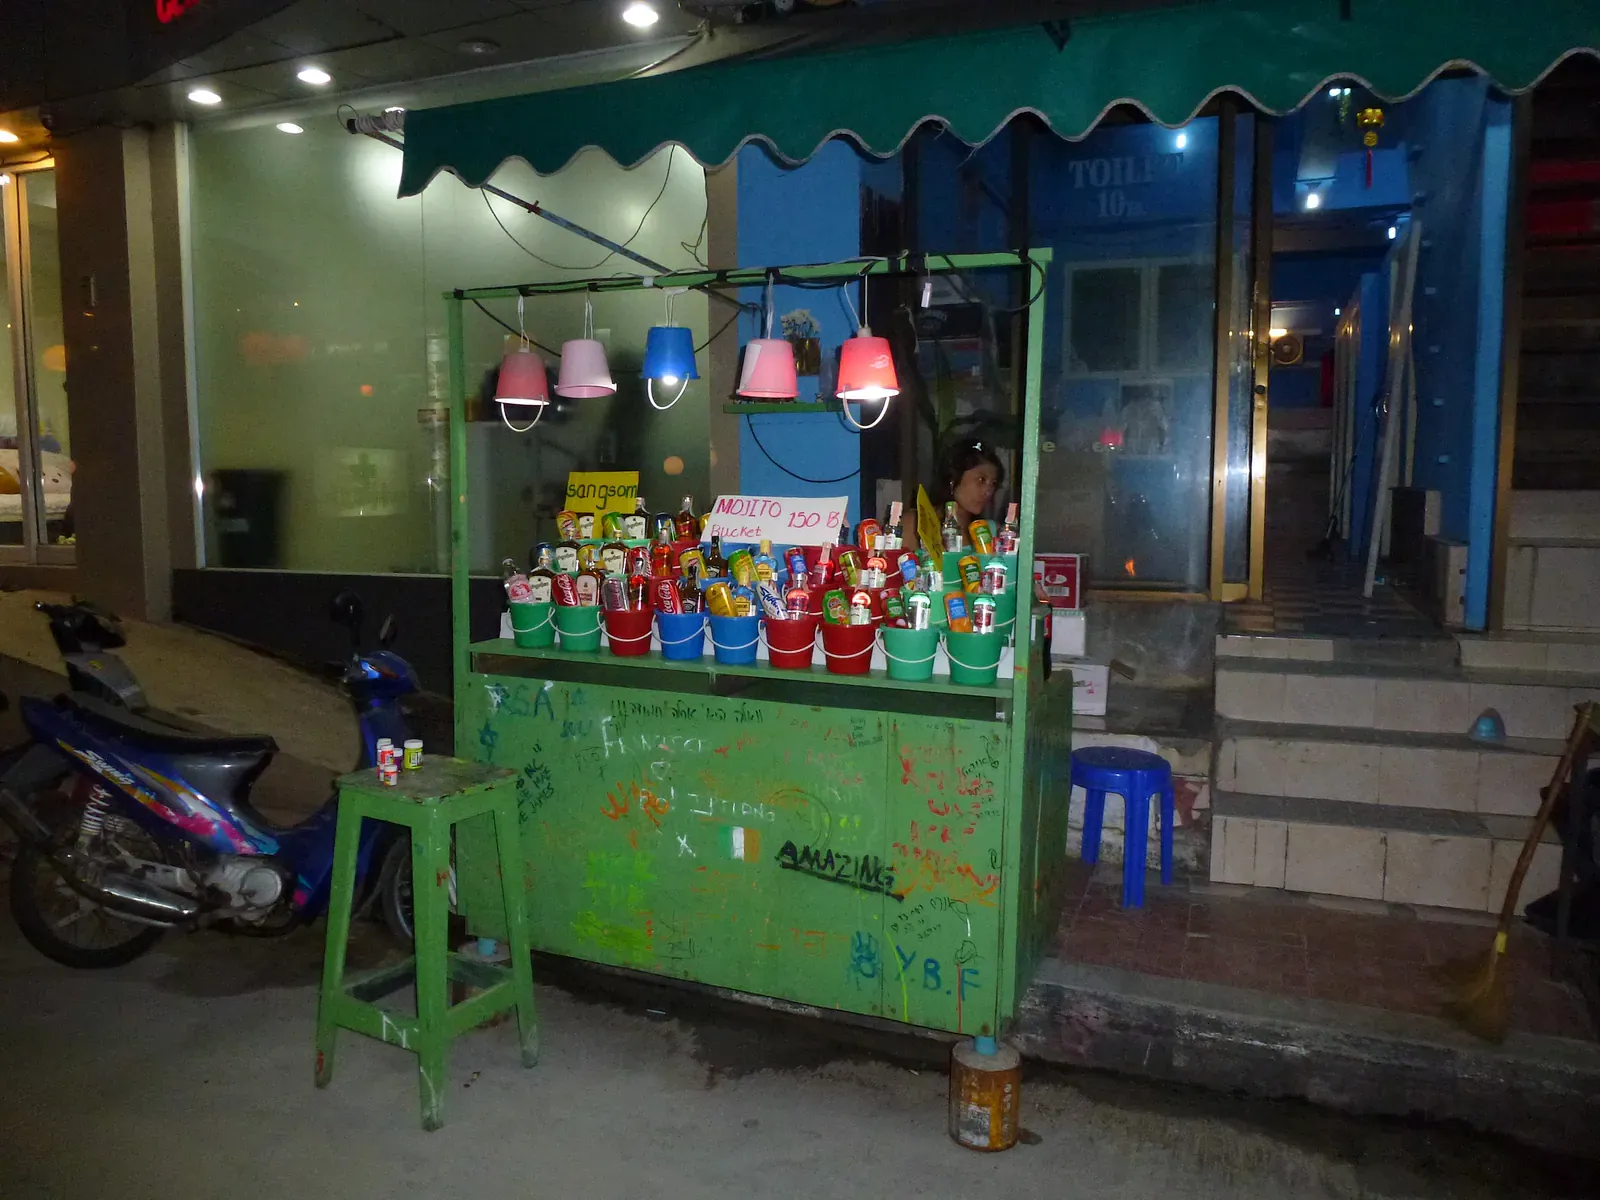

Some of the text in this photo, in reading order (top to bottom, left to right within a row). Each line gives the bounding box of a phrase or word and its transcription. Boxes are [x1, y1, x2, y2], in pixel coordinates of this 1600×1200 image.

[565, 484, 637, 510] sangsom
[715, 498, 782, 518] MOJITO
[787, 511, 820, 528] 150
